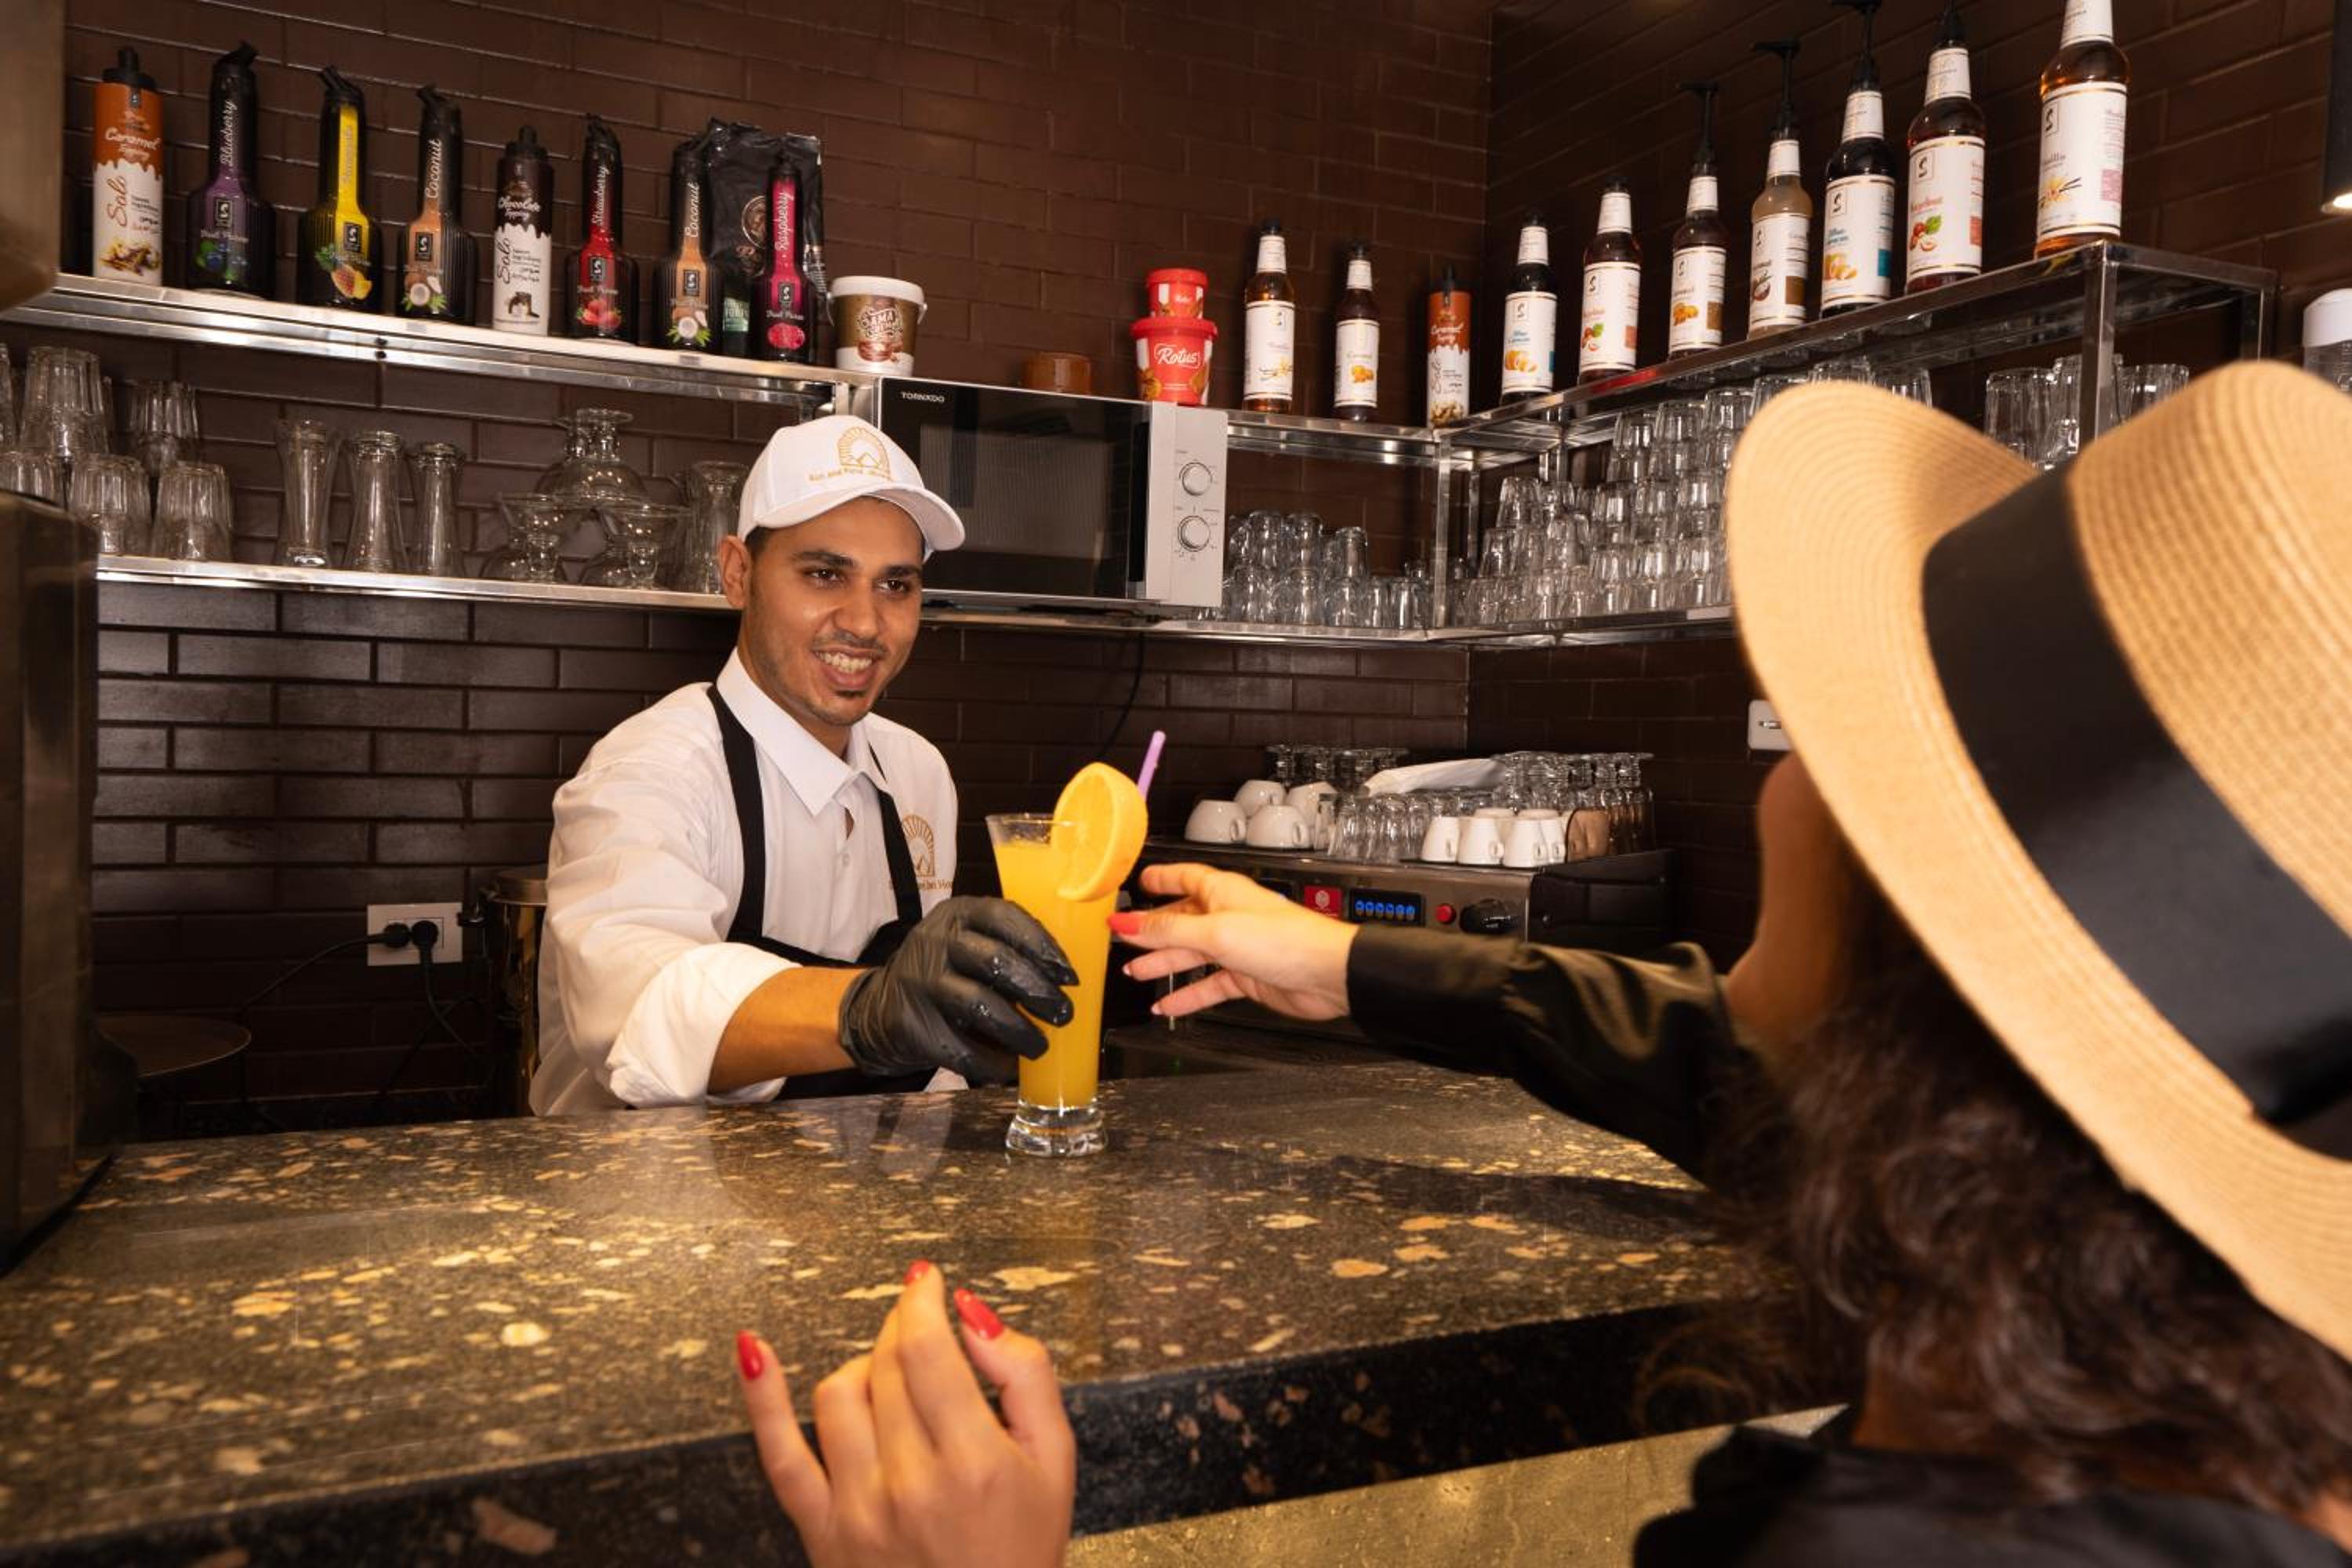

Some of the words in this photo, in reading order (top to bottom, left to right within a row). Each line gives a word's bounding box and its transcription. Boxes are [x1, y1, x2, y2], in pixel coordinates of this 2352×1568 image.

[220, 100, 238, 167] Blueberry
[425, 137, 443, 198] Coconut
[591, 165, 611, 226] Strawberry
[498, 195, 540, 212] Chocolate
[684, 181, 700, 238] Coconut
[773, 191, 794, 251] Raspberry
